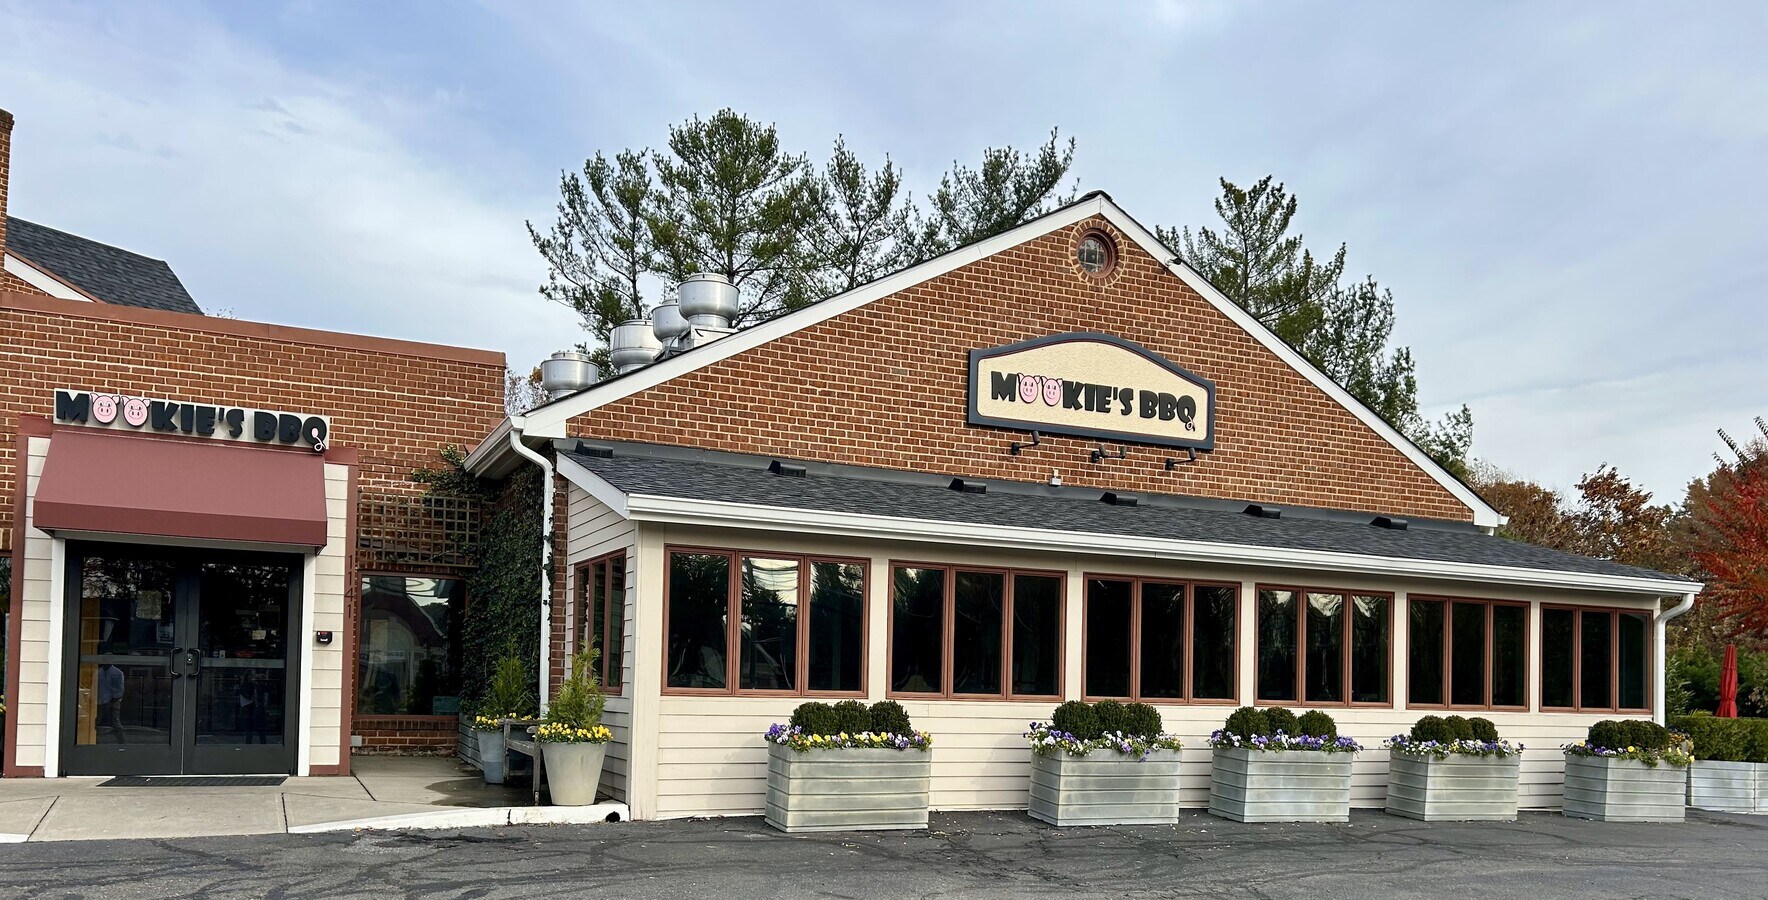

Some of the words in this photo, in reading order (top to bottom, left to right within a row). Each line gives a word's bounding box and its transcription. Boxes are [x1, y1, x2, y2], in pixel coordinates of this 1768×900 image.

[56, 391, 244, 437] MOOKIE'S
[254, 412, 327, 452] BBQ
[990, 371, 1133, 415] MOOKIE'S
[1139, 390, 1196, 431] BBQ
[344, 554, 355, 618] 1141
